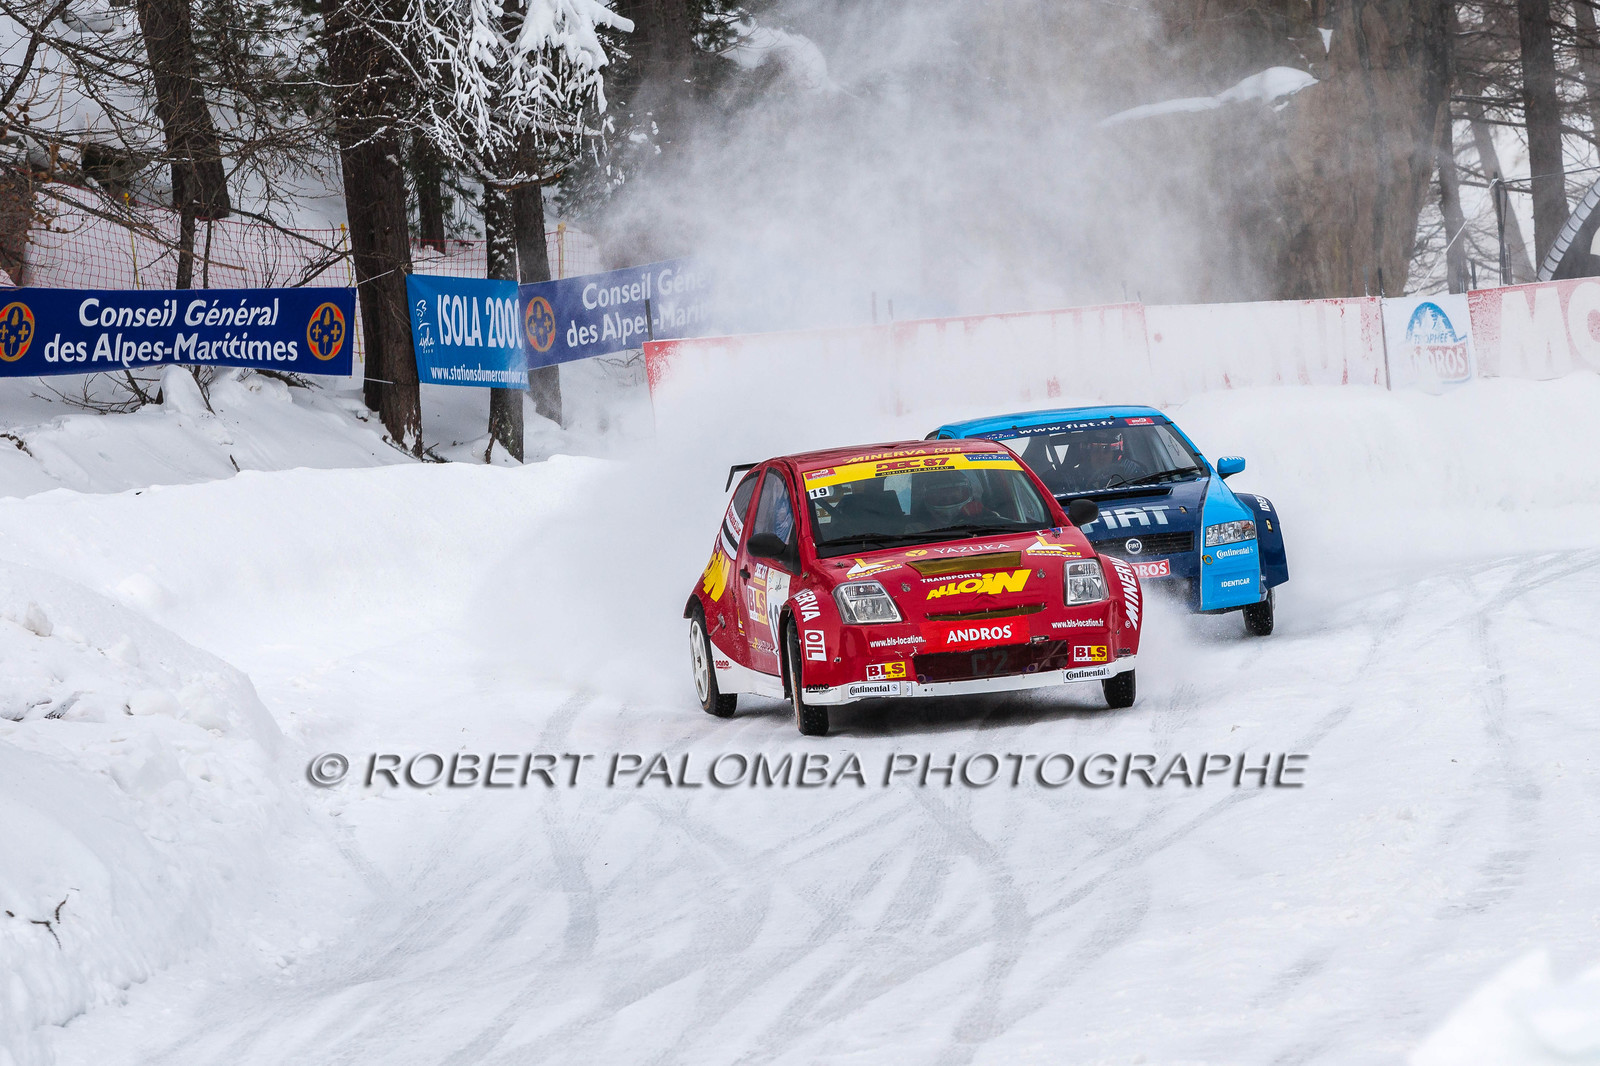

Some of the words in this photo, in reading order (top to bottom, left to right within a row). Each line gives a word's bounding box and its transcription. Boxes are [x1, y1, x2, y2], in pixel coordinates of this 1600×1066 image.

[582, 272, 651, 311] Conseil
[78, 298, 177, 327] Conseil
[184, 298, 279, 328] Général
[437, 294, 483, 348] ISOLA
[486, 297, 523, 350] 2000
[566, 321, 598, 348] des
[44, 333, 88, 363] des
[92, 332, 298, 367] Alpes-Maritimes
[1019, 421, 1114, 434] www.fiat.fr
[845, 449, 926, 464] MINERVA
[923, 457, 950, 467] 87
[811, 487, 827, 498] 19
[934, 543, 1011, 554] YAZUKA
[1127, 542, 1140, 551] FIAT
[1216, 547, 1250, 560] Continental
[920, 572, 982, 583] TRANSPORTS
[1221, 578, 1251, 588] IDENTICAR
[1051, 618, 1104, 629] www.bls-location.fr
[946, 625, 1013, 644] ANDROS
[805, 631, 825, 659] OIL
[1075, 647, 1107, 658] BLS
[868, 663, 905, 677] BLS
[1066, 668, 1106, 680] Continental
[850, 684, 890, 695] Continental
